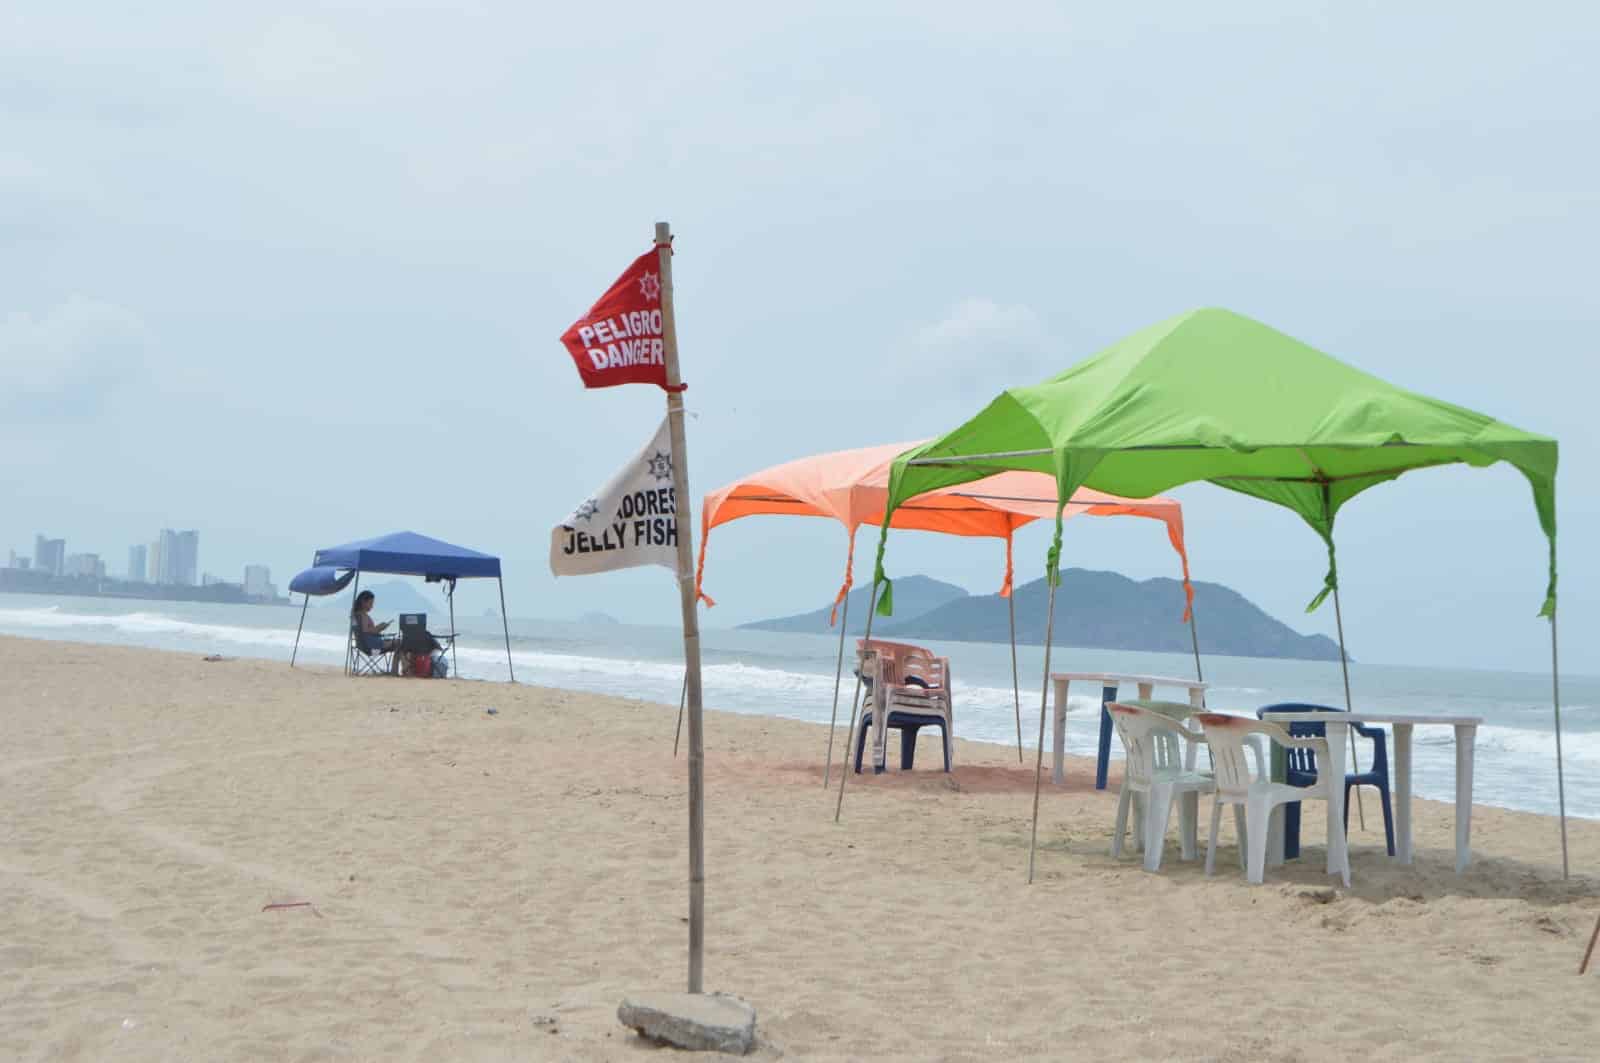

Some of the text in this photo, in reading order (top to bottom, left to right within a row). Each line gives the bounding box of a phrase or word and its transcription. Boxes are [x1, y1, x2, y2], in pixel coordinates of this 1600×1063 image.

[578, 310, 662, 348] PELIGRO
[588, 339, 664, 370] DANGER
[616, 488, 675, 519] DORES
[564, 518, 678, 555] JELLY FISH
